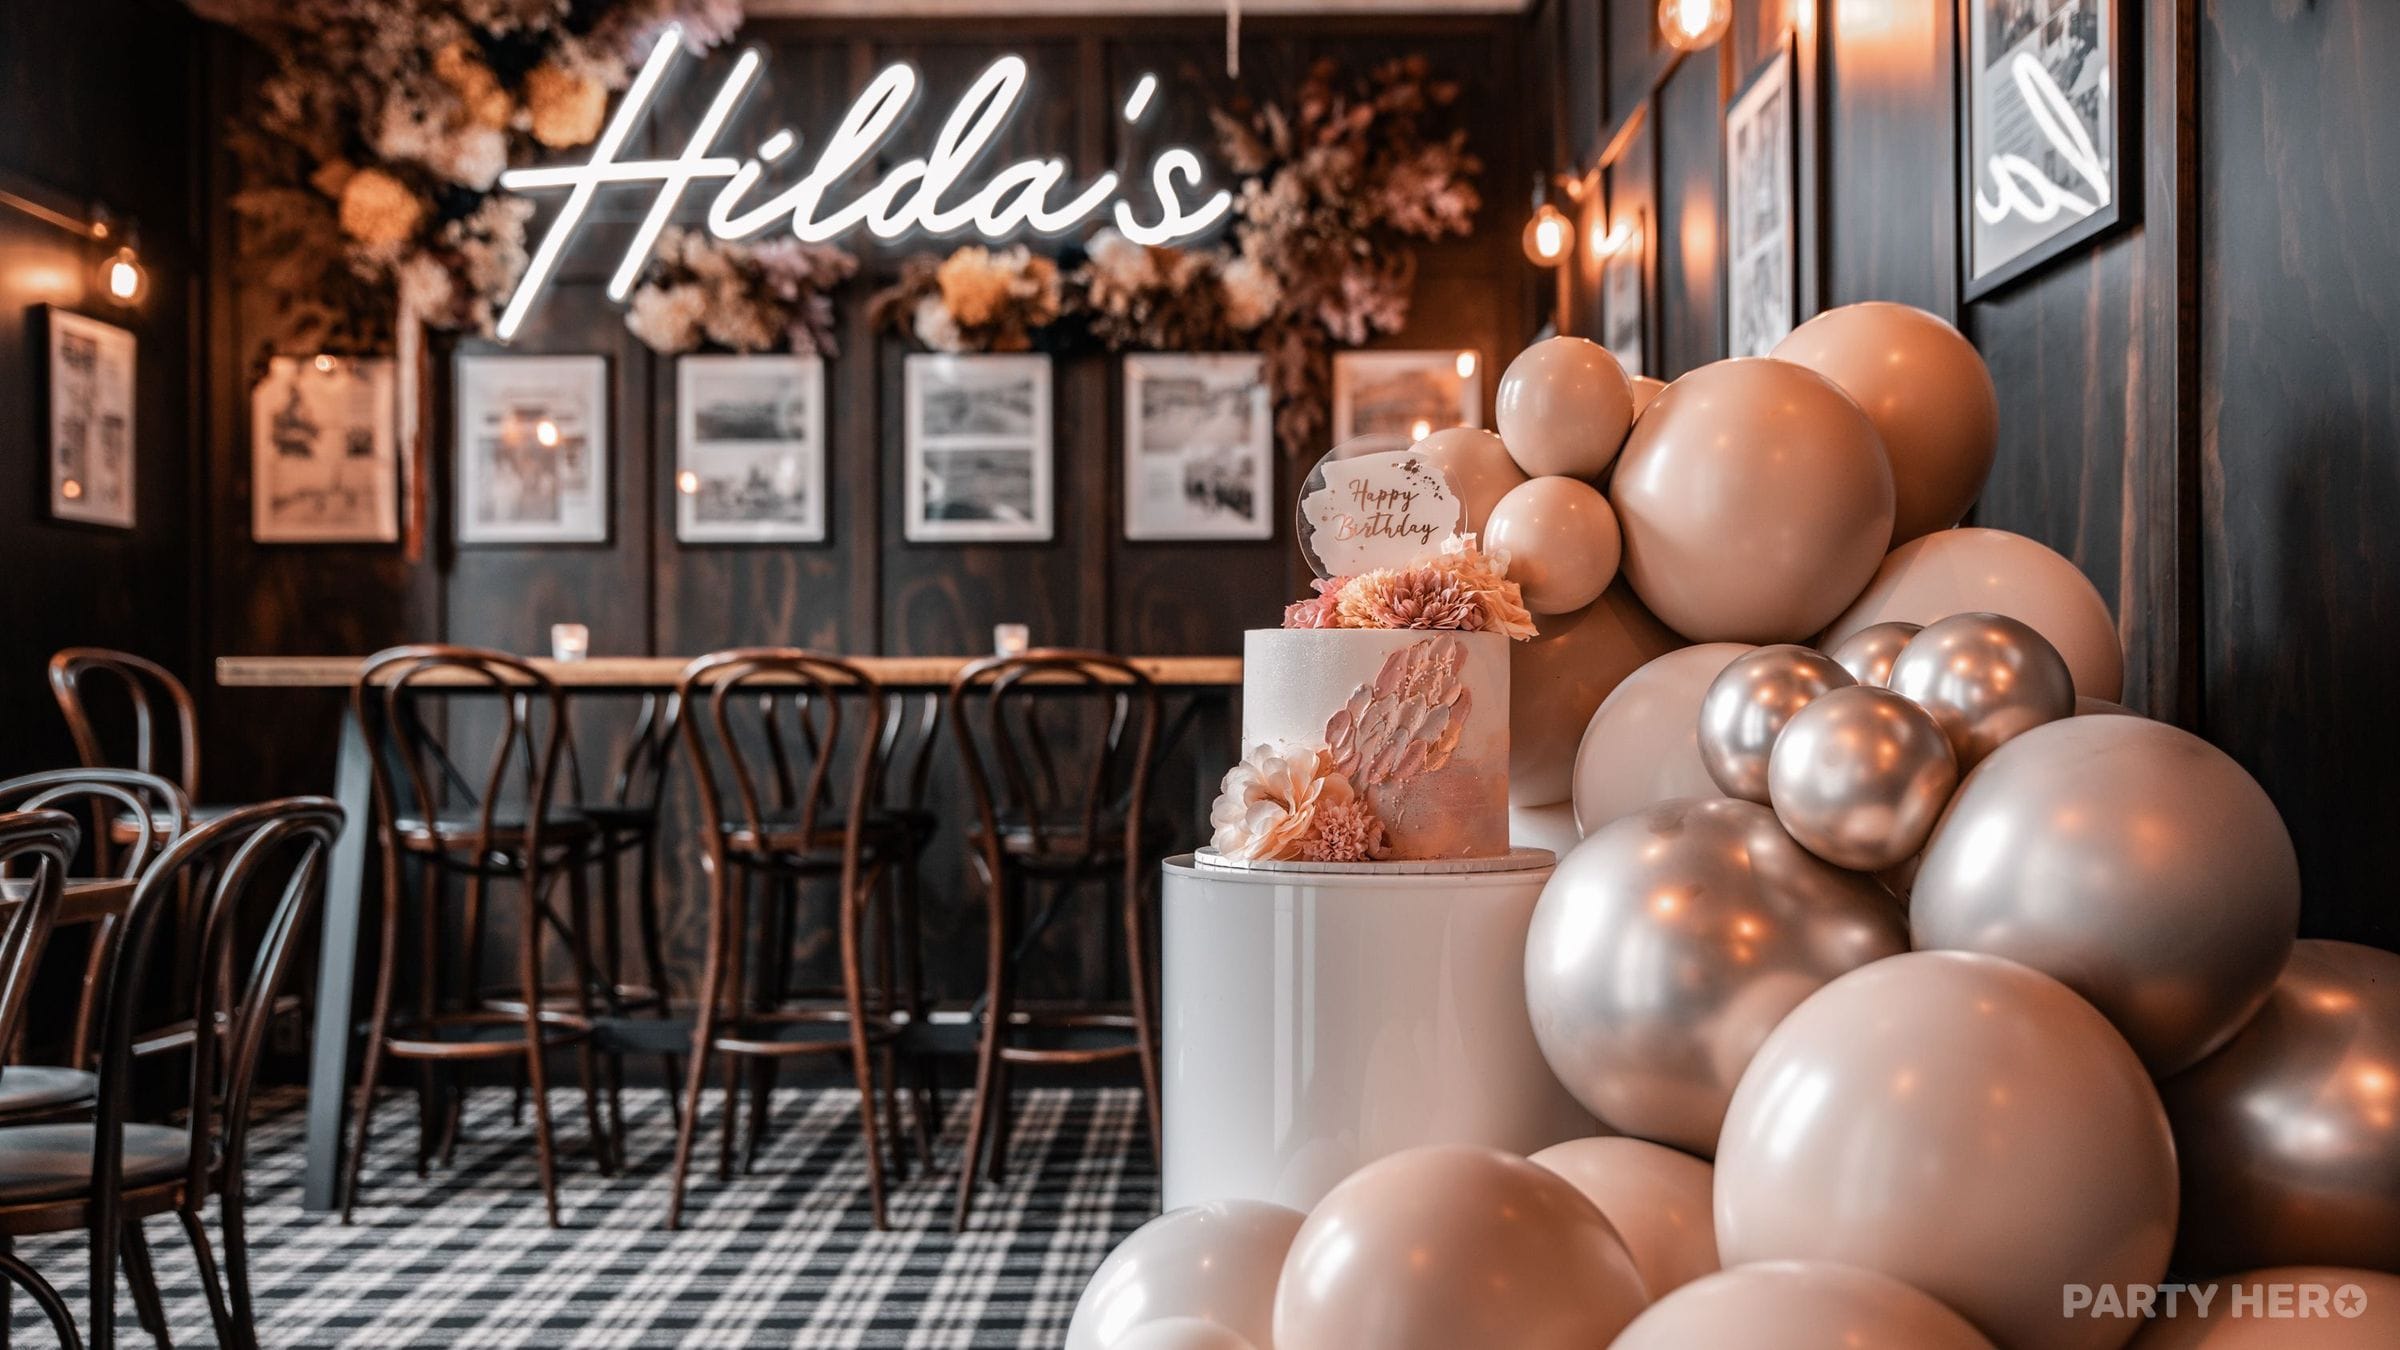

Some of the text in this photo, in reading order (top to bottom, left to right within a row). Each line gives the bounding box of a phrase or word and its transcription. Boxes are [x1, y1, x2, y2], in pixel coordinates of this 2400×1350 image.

[497, 22, 1233, 341] Hilda's
[1348, 478, 1420, 512] Happy
[1331, 511, 1439, 545] Birthday
